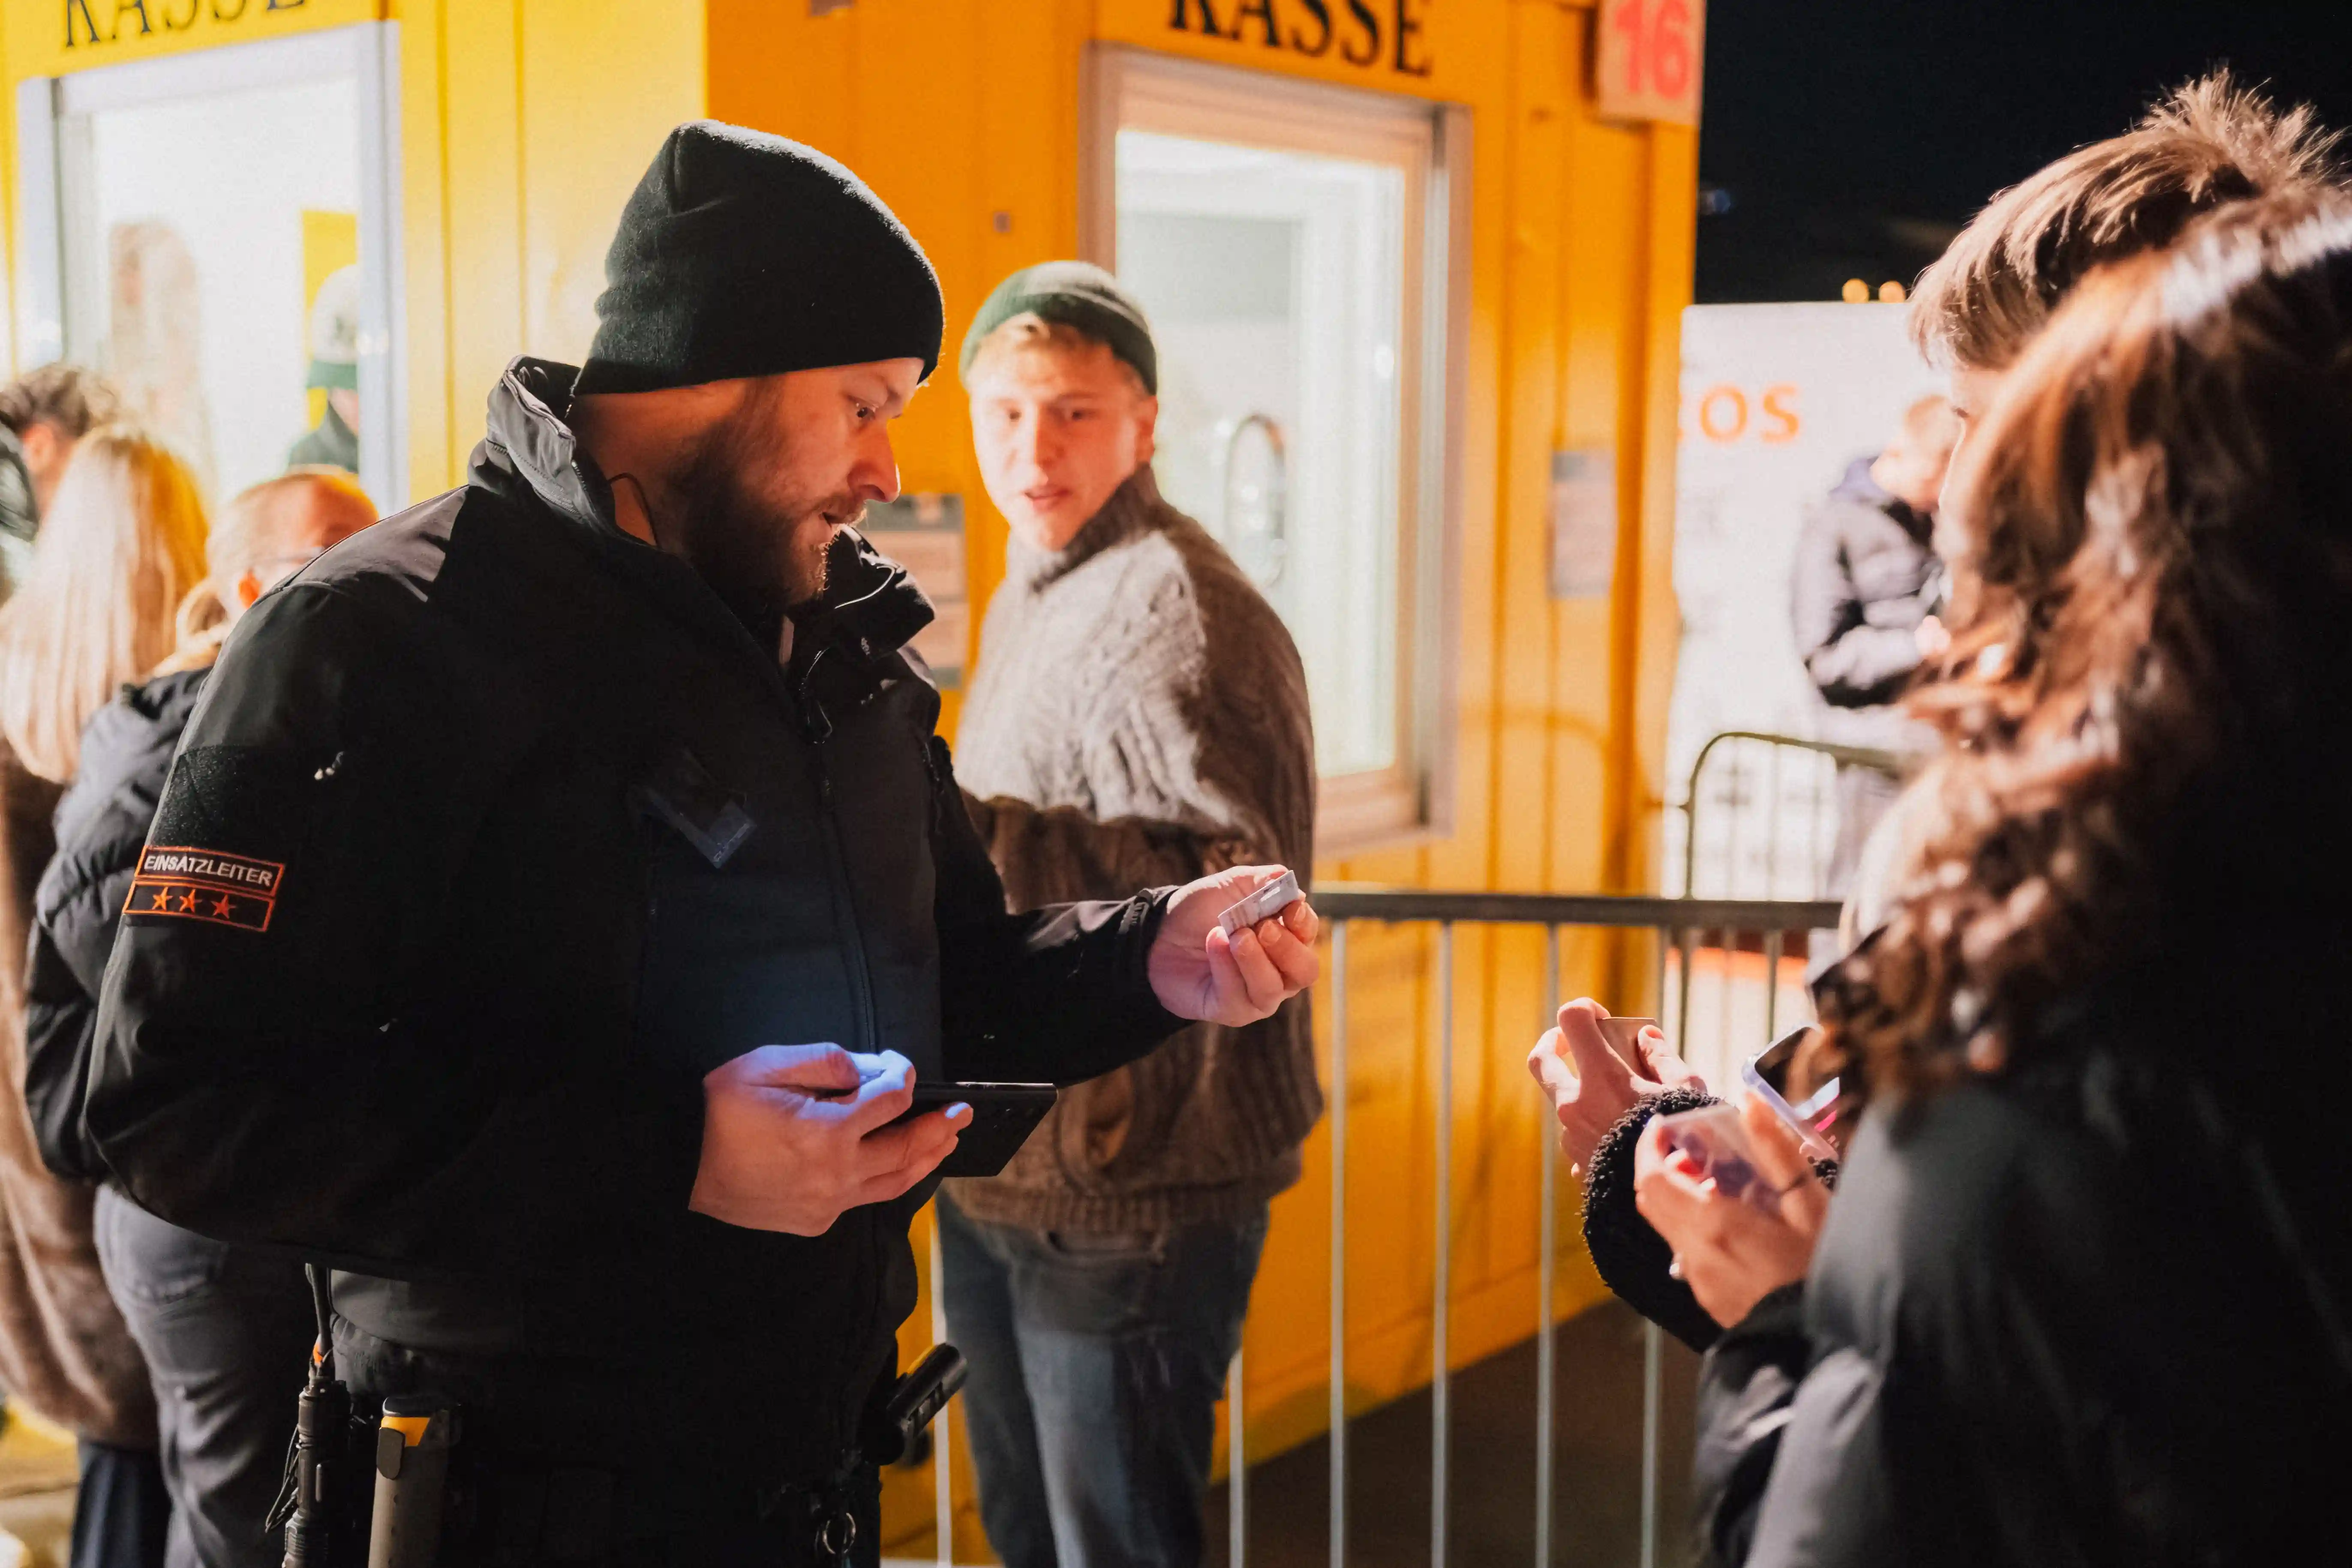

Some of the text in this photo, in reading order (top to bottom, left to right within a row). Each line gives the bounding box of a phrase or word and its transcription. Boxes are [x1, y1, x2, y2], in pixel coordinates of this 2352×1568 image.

[1615, 0, 1689, 99] 16
[1677, 383, 1802, 444] OS
[143, 853, 273, 887] EINSATZLEITER
